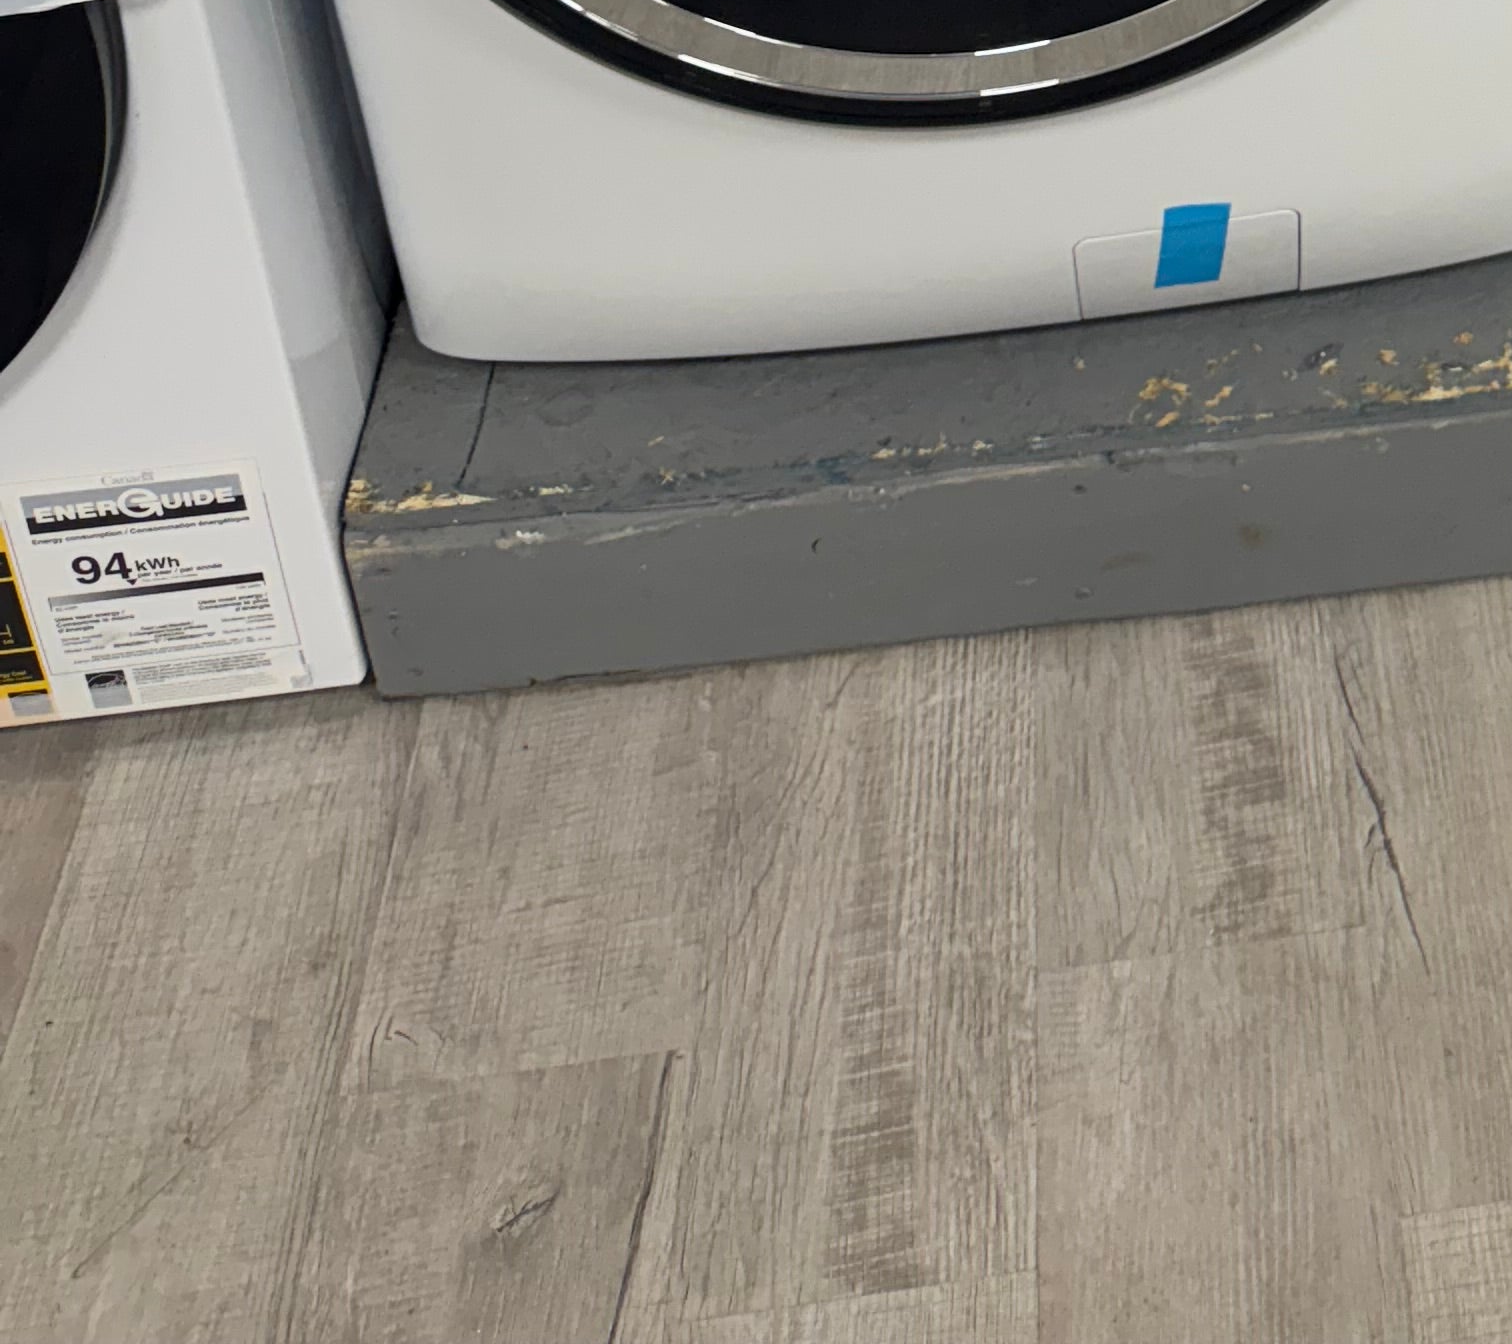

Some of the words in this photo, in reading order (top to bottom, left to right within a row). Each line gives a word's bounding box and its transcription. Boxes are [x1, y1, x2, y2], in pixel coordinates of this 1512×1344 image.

[32, 487, 237, 524] ENERGUIDE
[71, 552, 133, 585] 94
[134, 555, 180, 572] kWh
